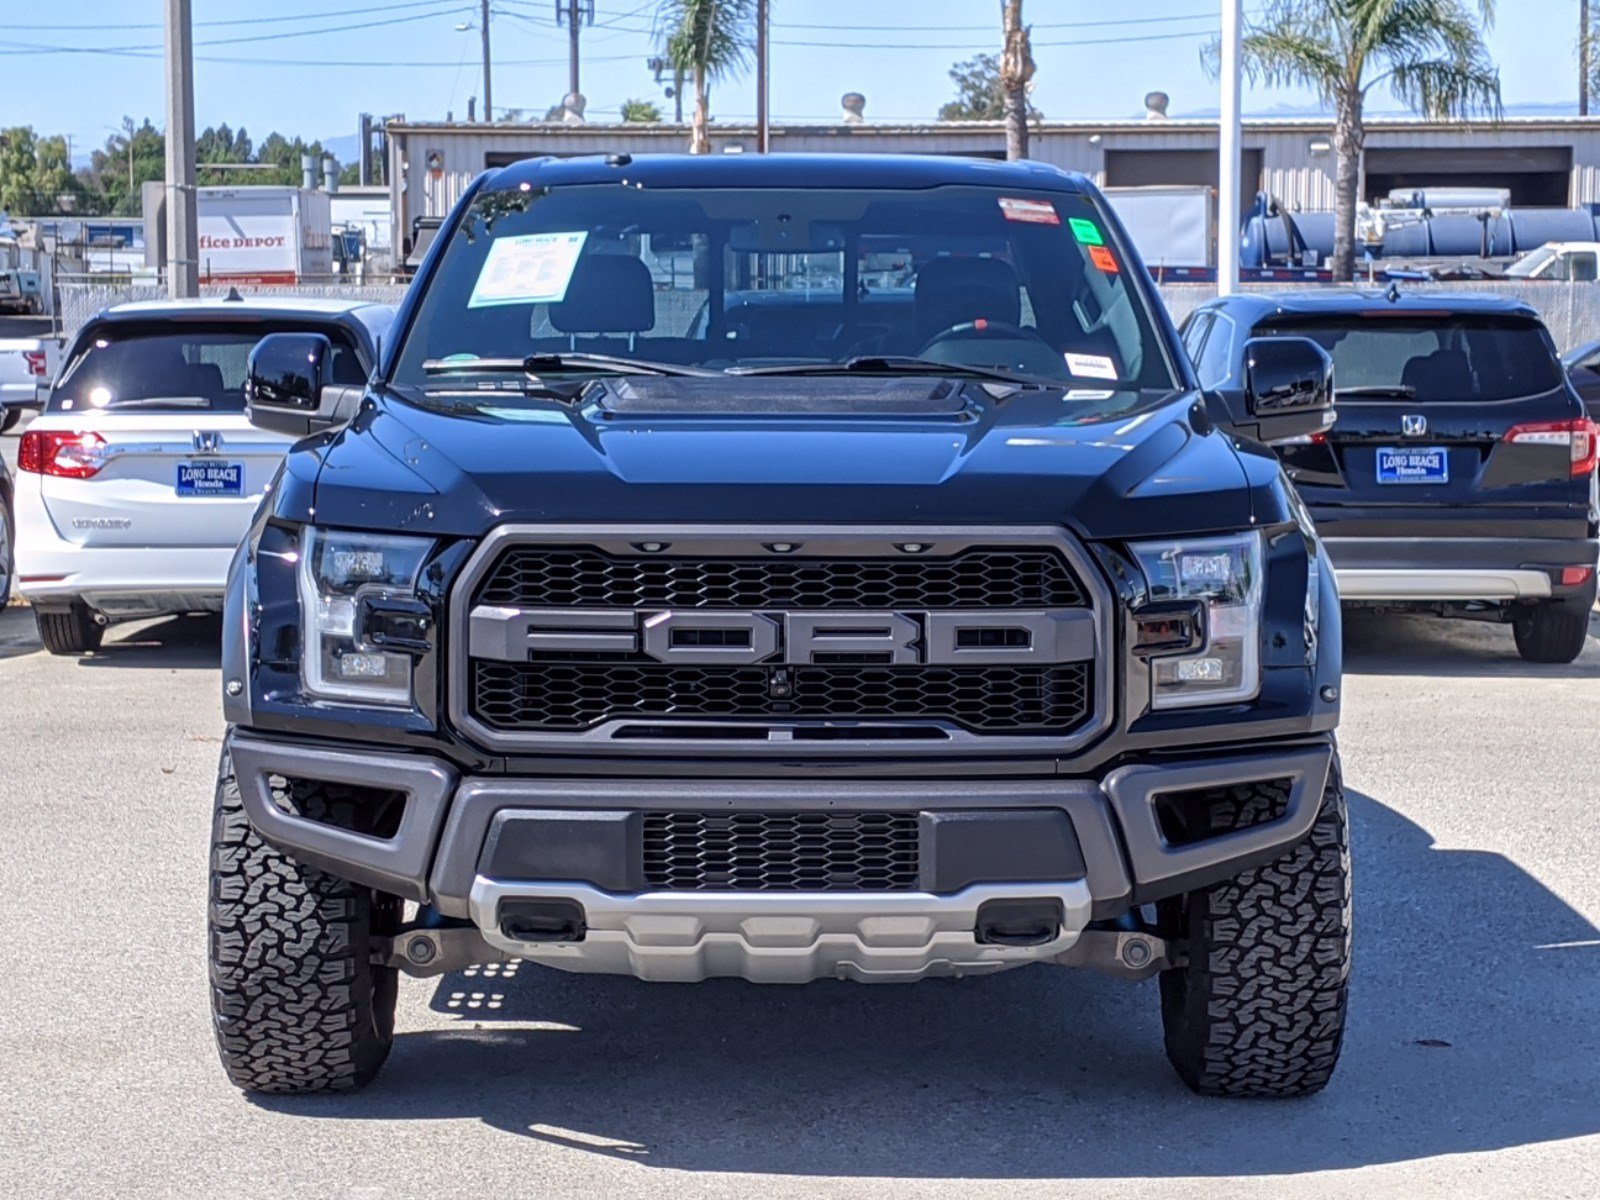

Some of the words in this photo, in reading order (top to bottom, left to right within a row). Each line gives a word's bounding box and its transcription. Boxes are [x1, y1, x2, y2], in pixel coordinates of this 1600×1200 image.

[233, 236, 285, 248] DEPOT
[1383, 455, 1408, 469] LONG
[1409, 455, 1440, 468] BEACH
[181, 468, 206, 482] LONG
[207, 468, 237, 482] BEACH
[1396, 467, 1427, 475] Honda
[194, 480, 224, 488] Honda
[469, 607, 1096, 665] FORD
